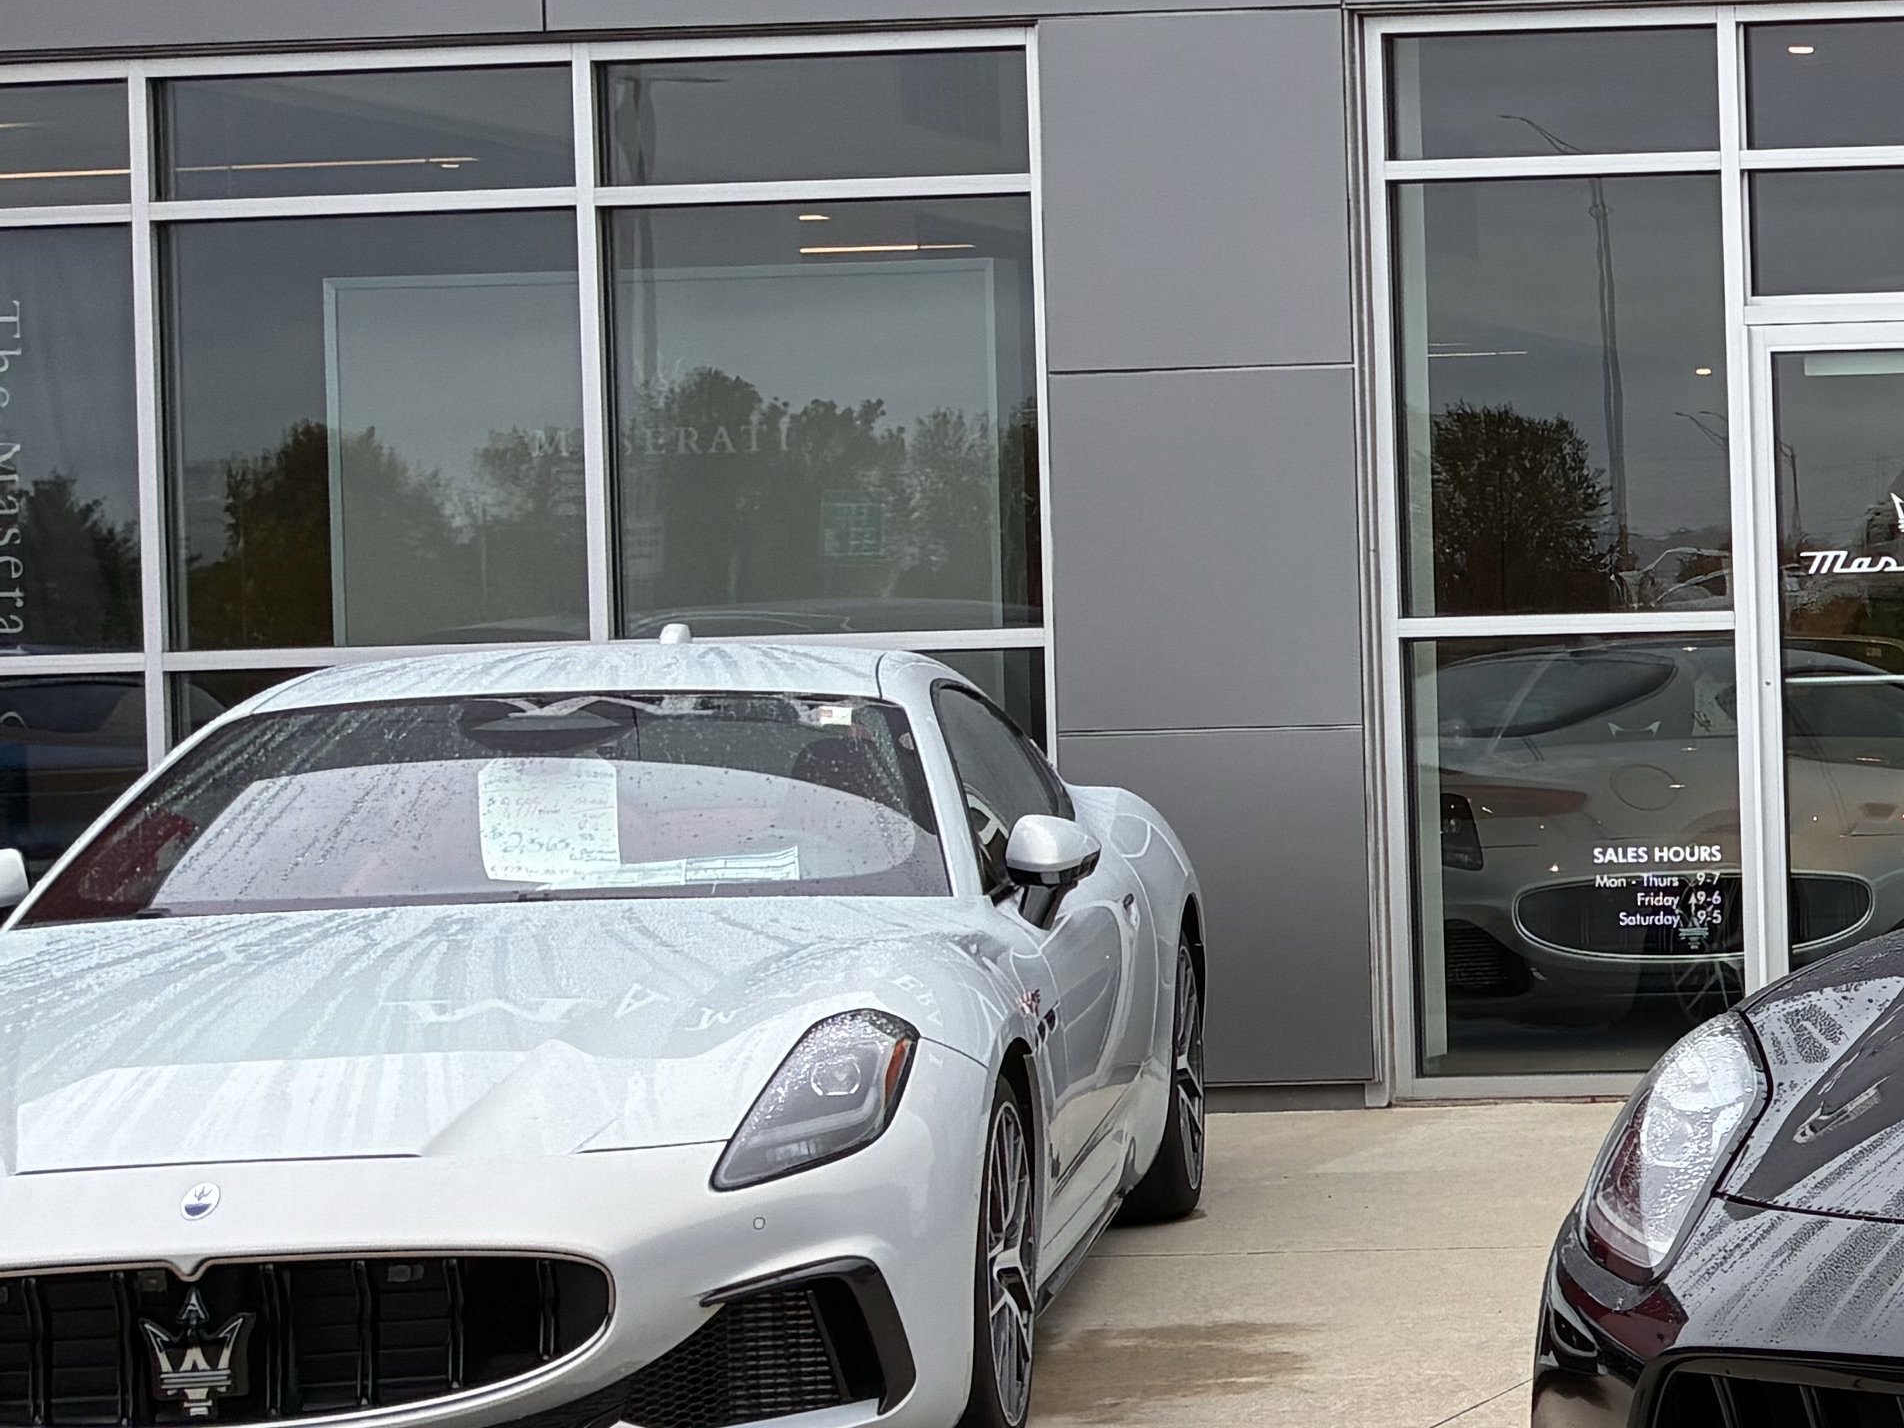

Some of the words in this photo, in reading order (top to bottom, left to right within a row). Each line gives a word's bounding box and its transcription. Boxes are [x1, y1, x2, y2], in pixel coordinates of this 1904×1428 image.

[530, 419, 790, 457] MERATI
[1593, 846, 1648, 864] SALES
[1654, 845, 1721, 862] HOURS
[1595, 874, 1626, 888] Mon
[1641, 873, 1679, 887] Thurs
[1696, 872, 1720, 885] 9-7
[1637, 892, 1680, 909] Friday
[1697, 891, 1721, 904] 9-6
[1619, 911, 1680, 928] Saturday
[1697, 910, 1721, 924] 9-5
